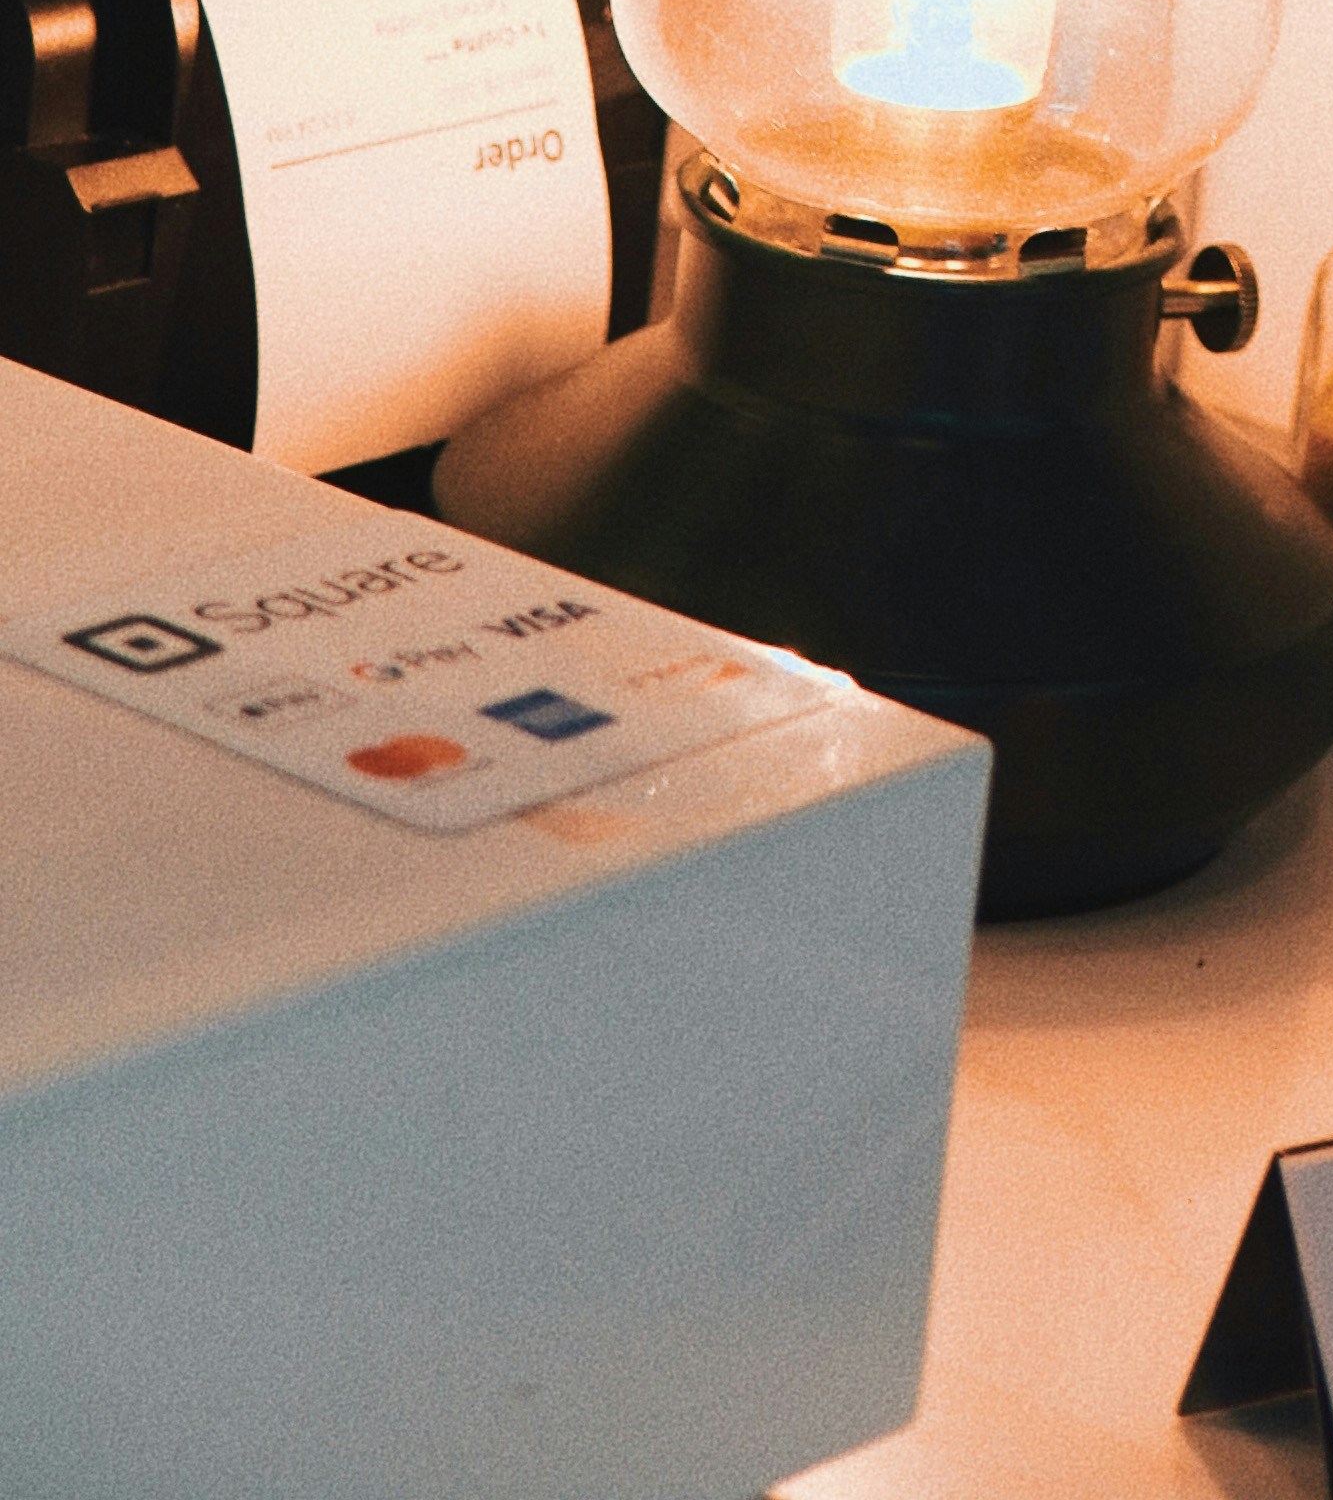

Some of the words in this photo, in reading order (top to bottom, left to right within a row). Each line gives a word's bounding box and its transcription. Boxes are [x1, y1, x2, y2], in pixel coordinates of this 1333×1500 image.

[473, 128, 563, 171] Order
[192, 552, 463, 632] Square
[480, 599, 600, 638] VISA
